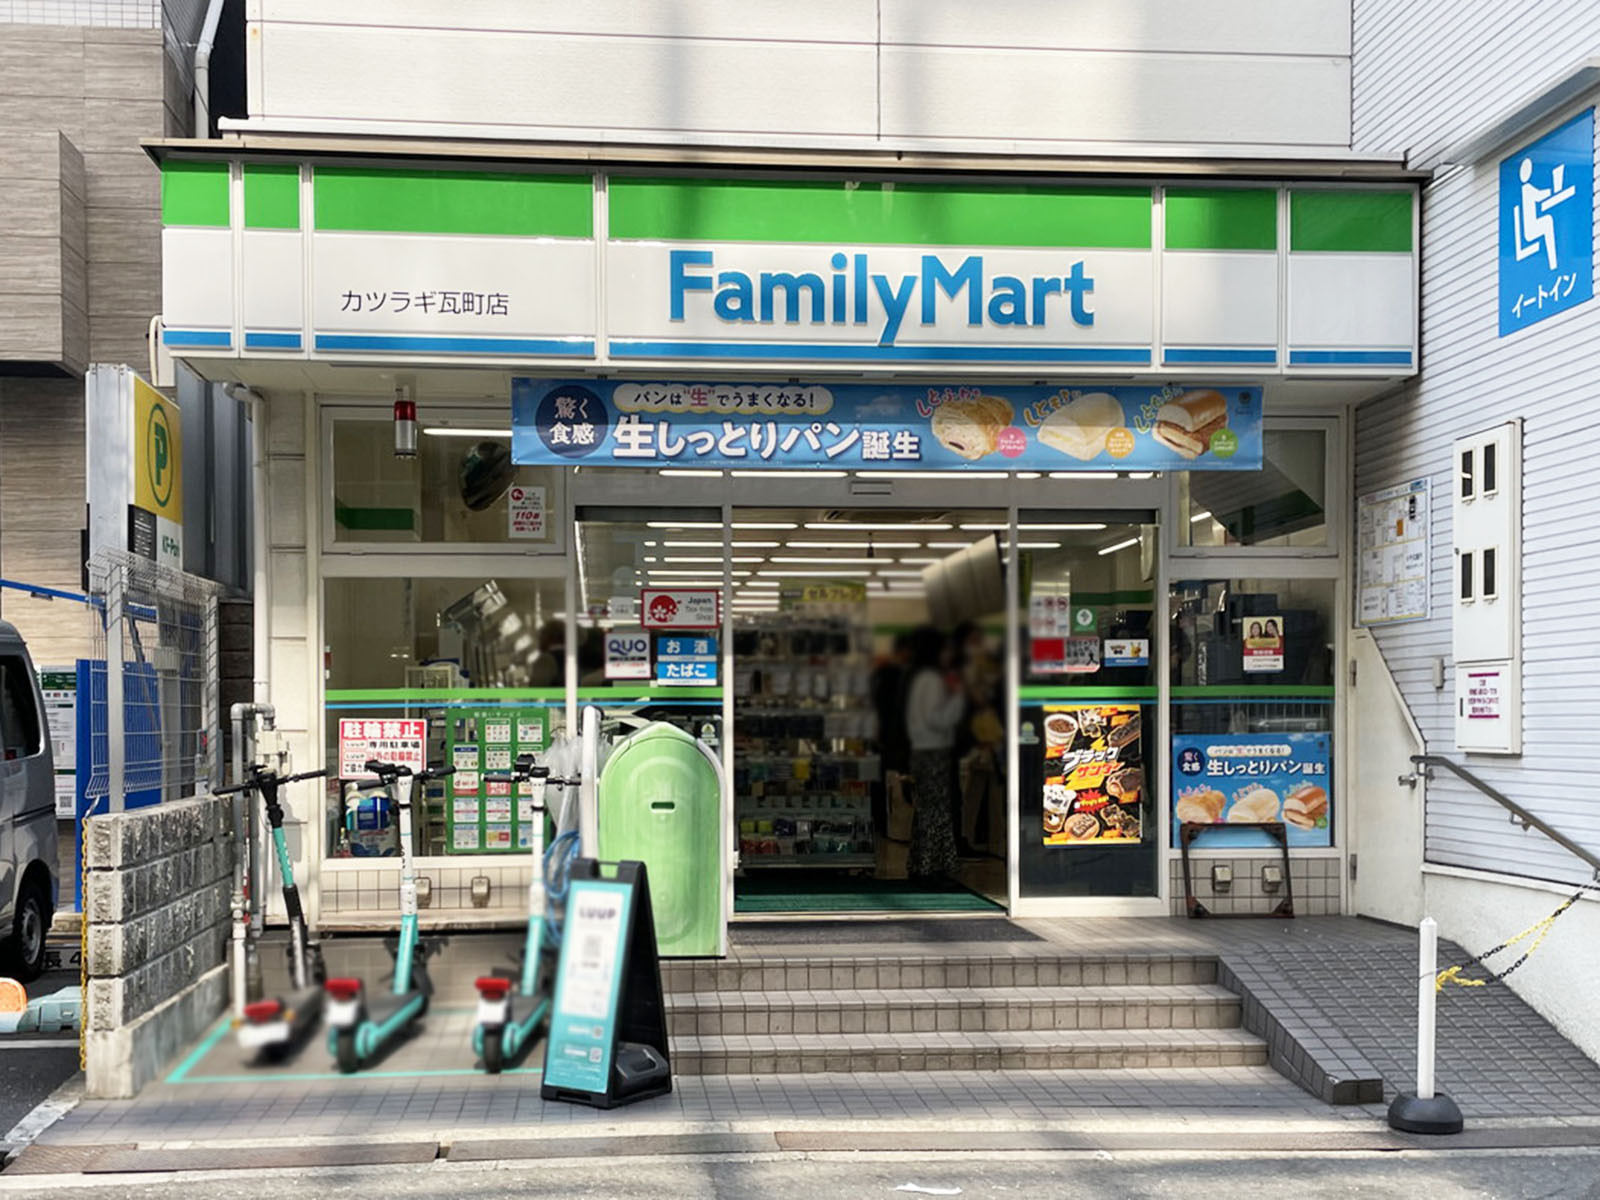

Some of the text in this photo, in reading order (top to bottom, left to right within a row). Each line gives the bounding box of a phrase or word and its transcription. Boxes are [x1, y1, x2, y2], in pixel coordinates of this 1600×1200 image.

[341, 289, 509, 315] カツラギ瓦町店
[669, 250, 1095, 347] FamilyMart
[1511, 272, 1577, 319] イートイン
[554, 396, 588, 419] 驚く
[549, 421, 595, 445] 食感
[608, 639, 647, 656] QUO
[666, 663, 708, 678] たばこ
[343, 722, 421, 738] 駐輪禁止
